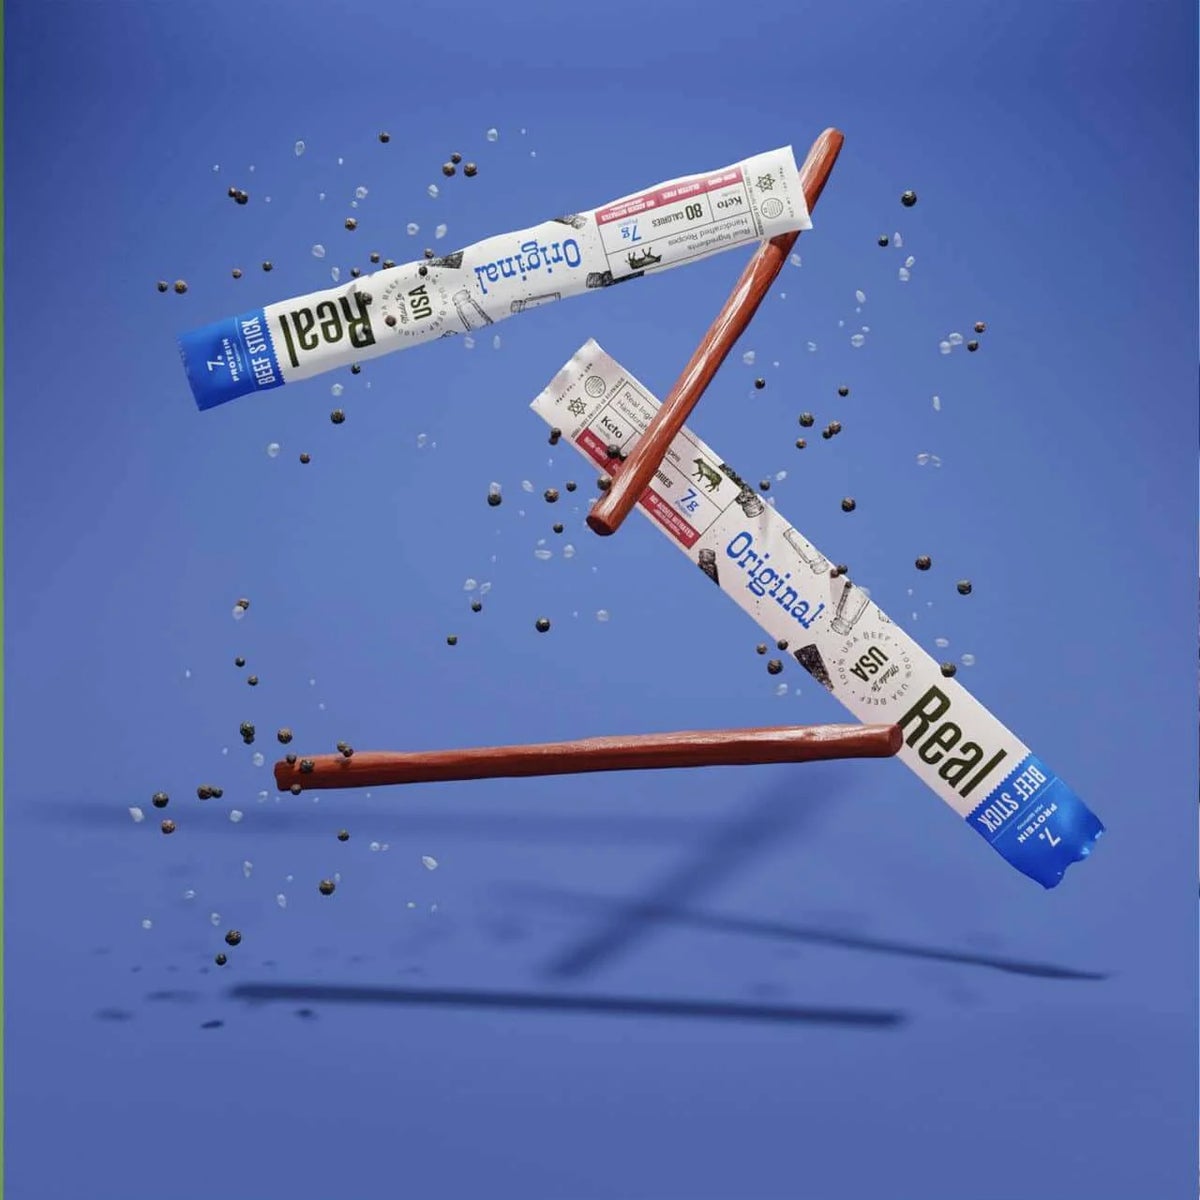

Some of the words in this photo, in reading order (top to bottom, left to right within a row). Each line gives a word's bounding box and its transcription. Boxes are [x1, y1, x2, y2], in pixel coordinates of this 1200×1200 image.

[684, 202, 703, 221] 80
[716, 195, 743, 209] Keto
[620, 224, 642, 242] 7g
[650, 210, 685, 228] CALORIES
[698, 217, 748, 238] Handcrafted
[732, 226, 751, 239] Real
[667, 232, 699, 246] Recipes
[686, 233, 731, 251] Ingredients
[473, 238, 582, 295] Original
[407, 283, 433, 321] USA
[240, 315, 267, 354] STICK
[278, 290, 377, 368] Real
[221, 337, 240, 382] PROTEIN
[250, 356, 276, 385] BEEF
[622, 390, 641, 408] Real
[600, 415, 623, 439] Keto
[616, 399, 650, 432] Handcraf
[679, 487, 699, 512] 7g
[725, 530, 825, 630] Original
[848, 645, 889, 682] USA
[897, 684, 1008, 799] Real
[1012, 763, 1047, 801] BEEF
[976, 791, 1019, 833] STICK
[1017, 802, 1058, 843] PROTEIN
